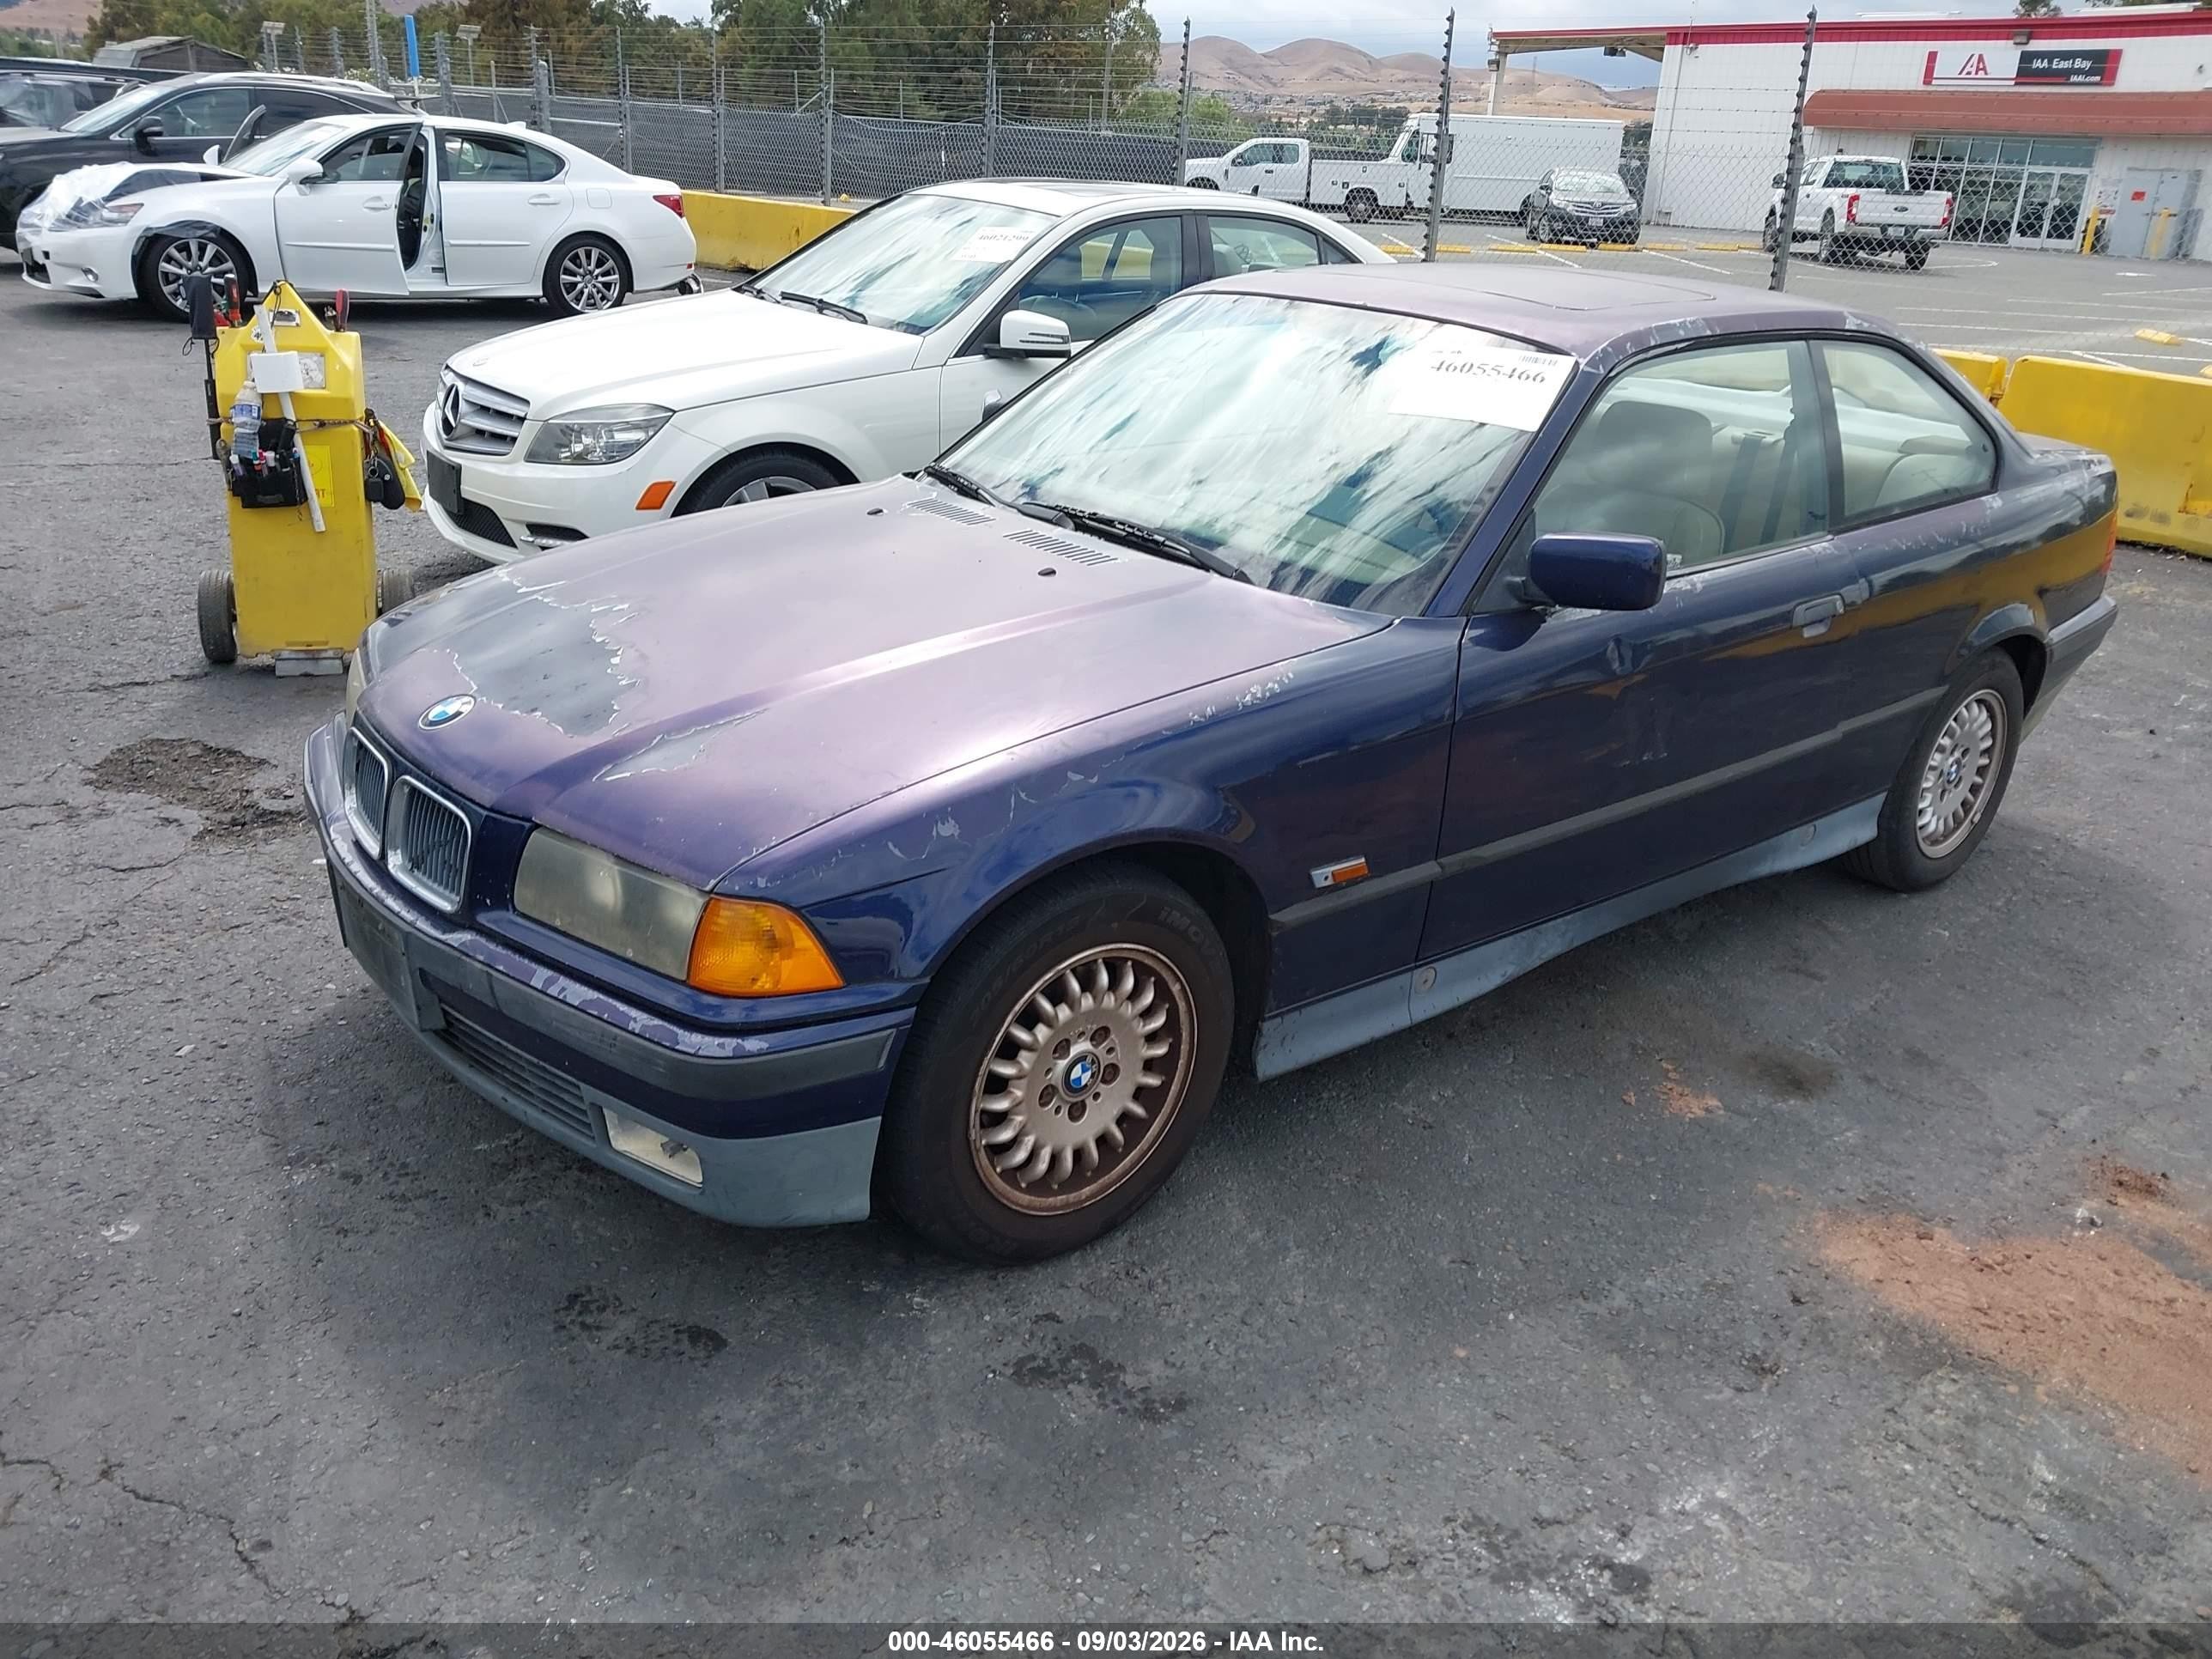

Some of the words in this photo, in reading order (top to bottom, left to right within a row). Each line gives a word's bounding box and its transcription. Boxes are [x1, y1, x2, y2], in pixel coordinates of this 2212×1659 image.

[2033, 58, 2048, 69] IAA
[2052, 58, 2073, 69] East
[2075, 57, 2093, 70] Bay
[1431, 360, 1545, 383] 46055466
